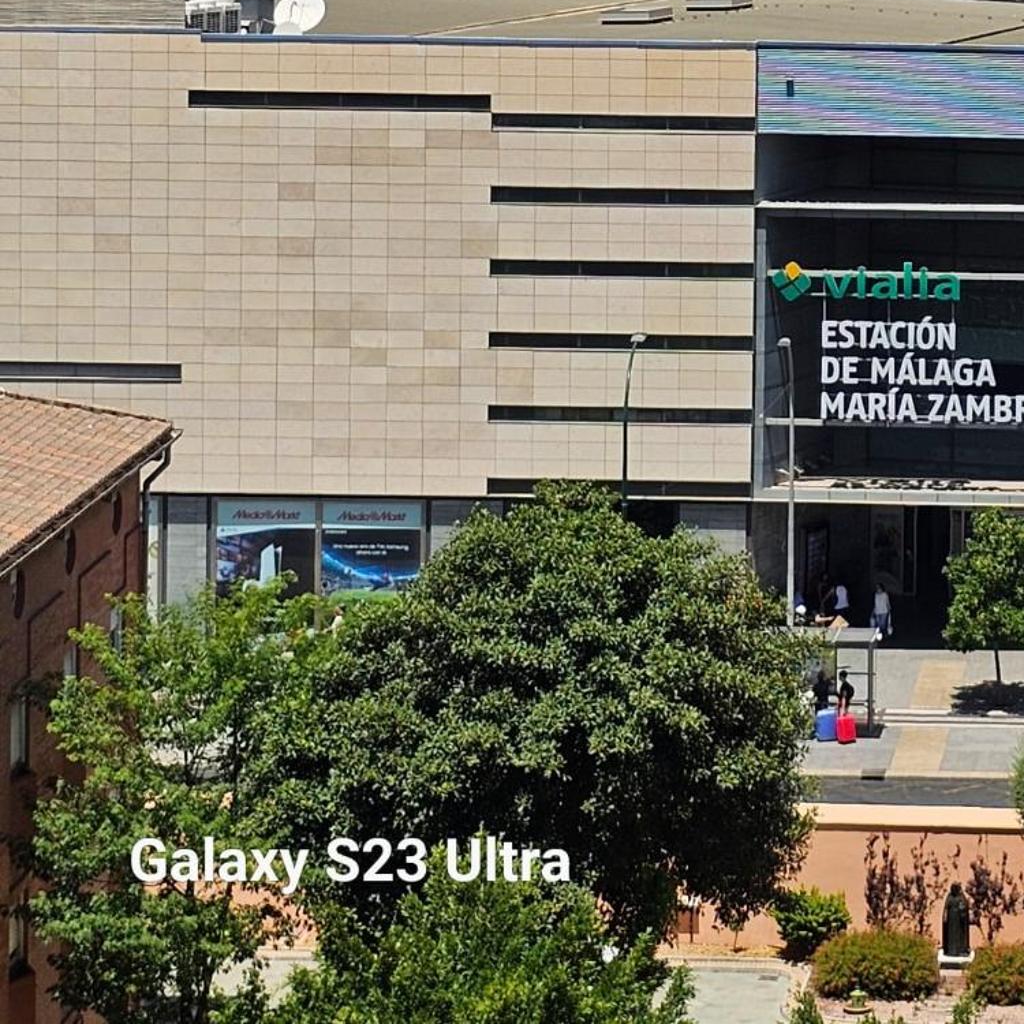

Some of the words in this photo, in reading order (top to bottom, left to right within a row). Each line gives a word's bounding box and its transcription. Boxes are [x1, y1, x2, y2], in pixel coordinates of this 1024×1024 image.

[823, 262, 960, 301] vialia
[821, 316, 956, 350] ESTACIÓN
[821, 356, 858, 384] DE
[870, 352, 996, 387] MÁLAGA
[820, 387, 917, 421] MARÍA
